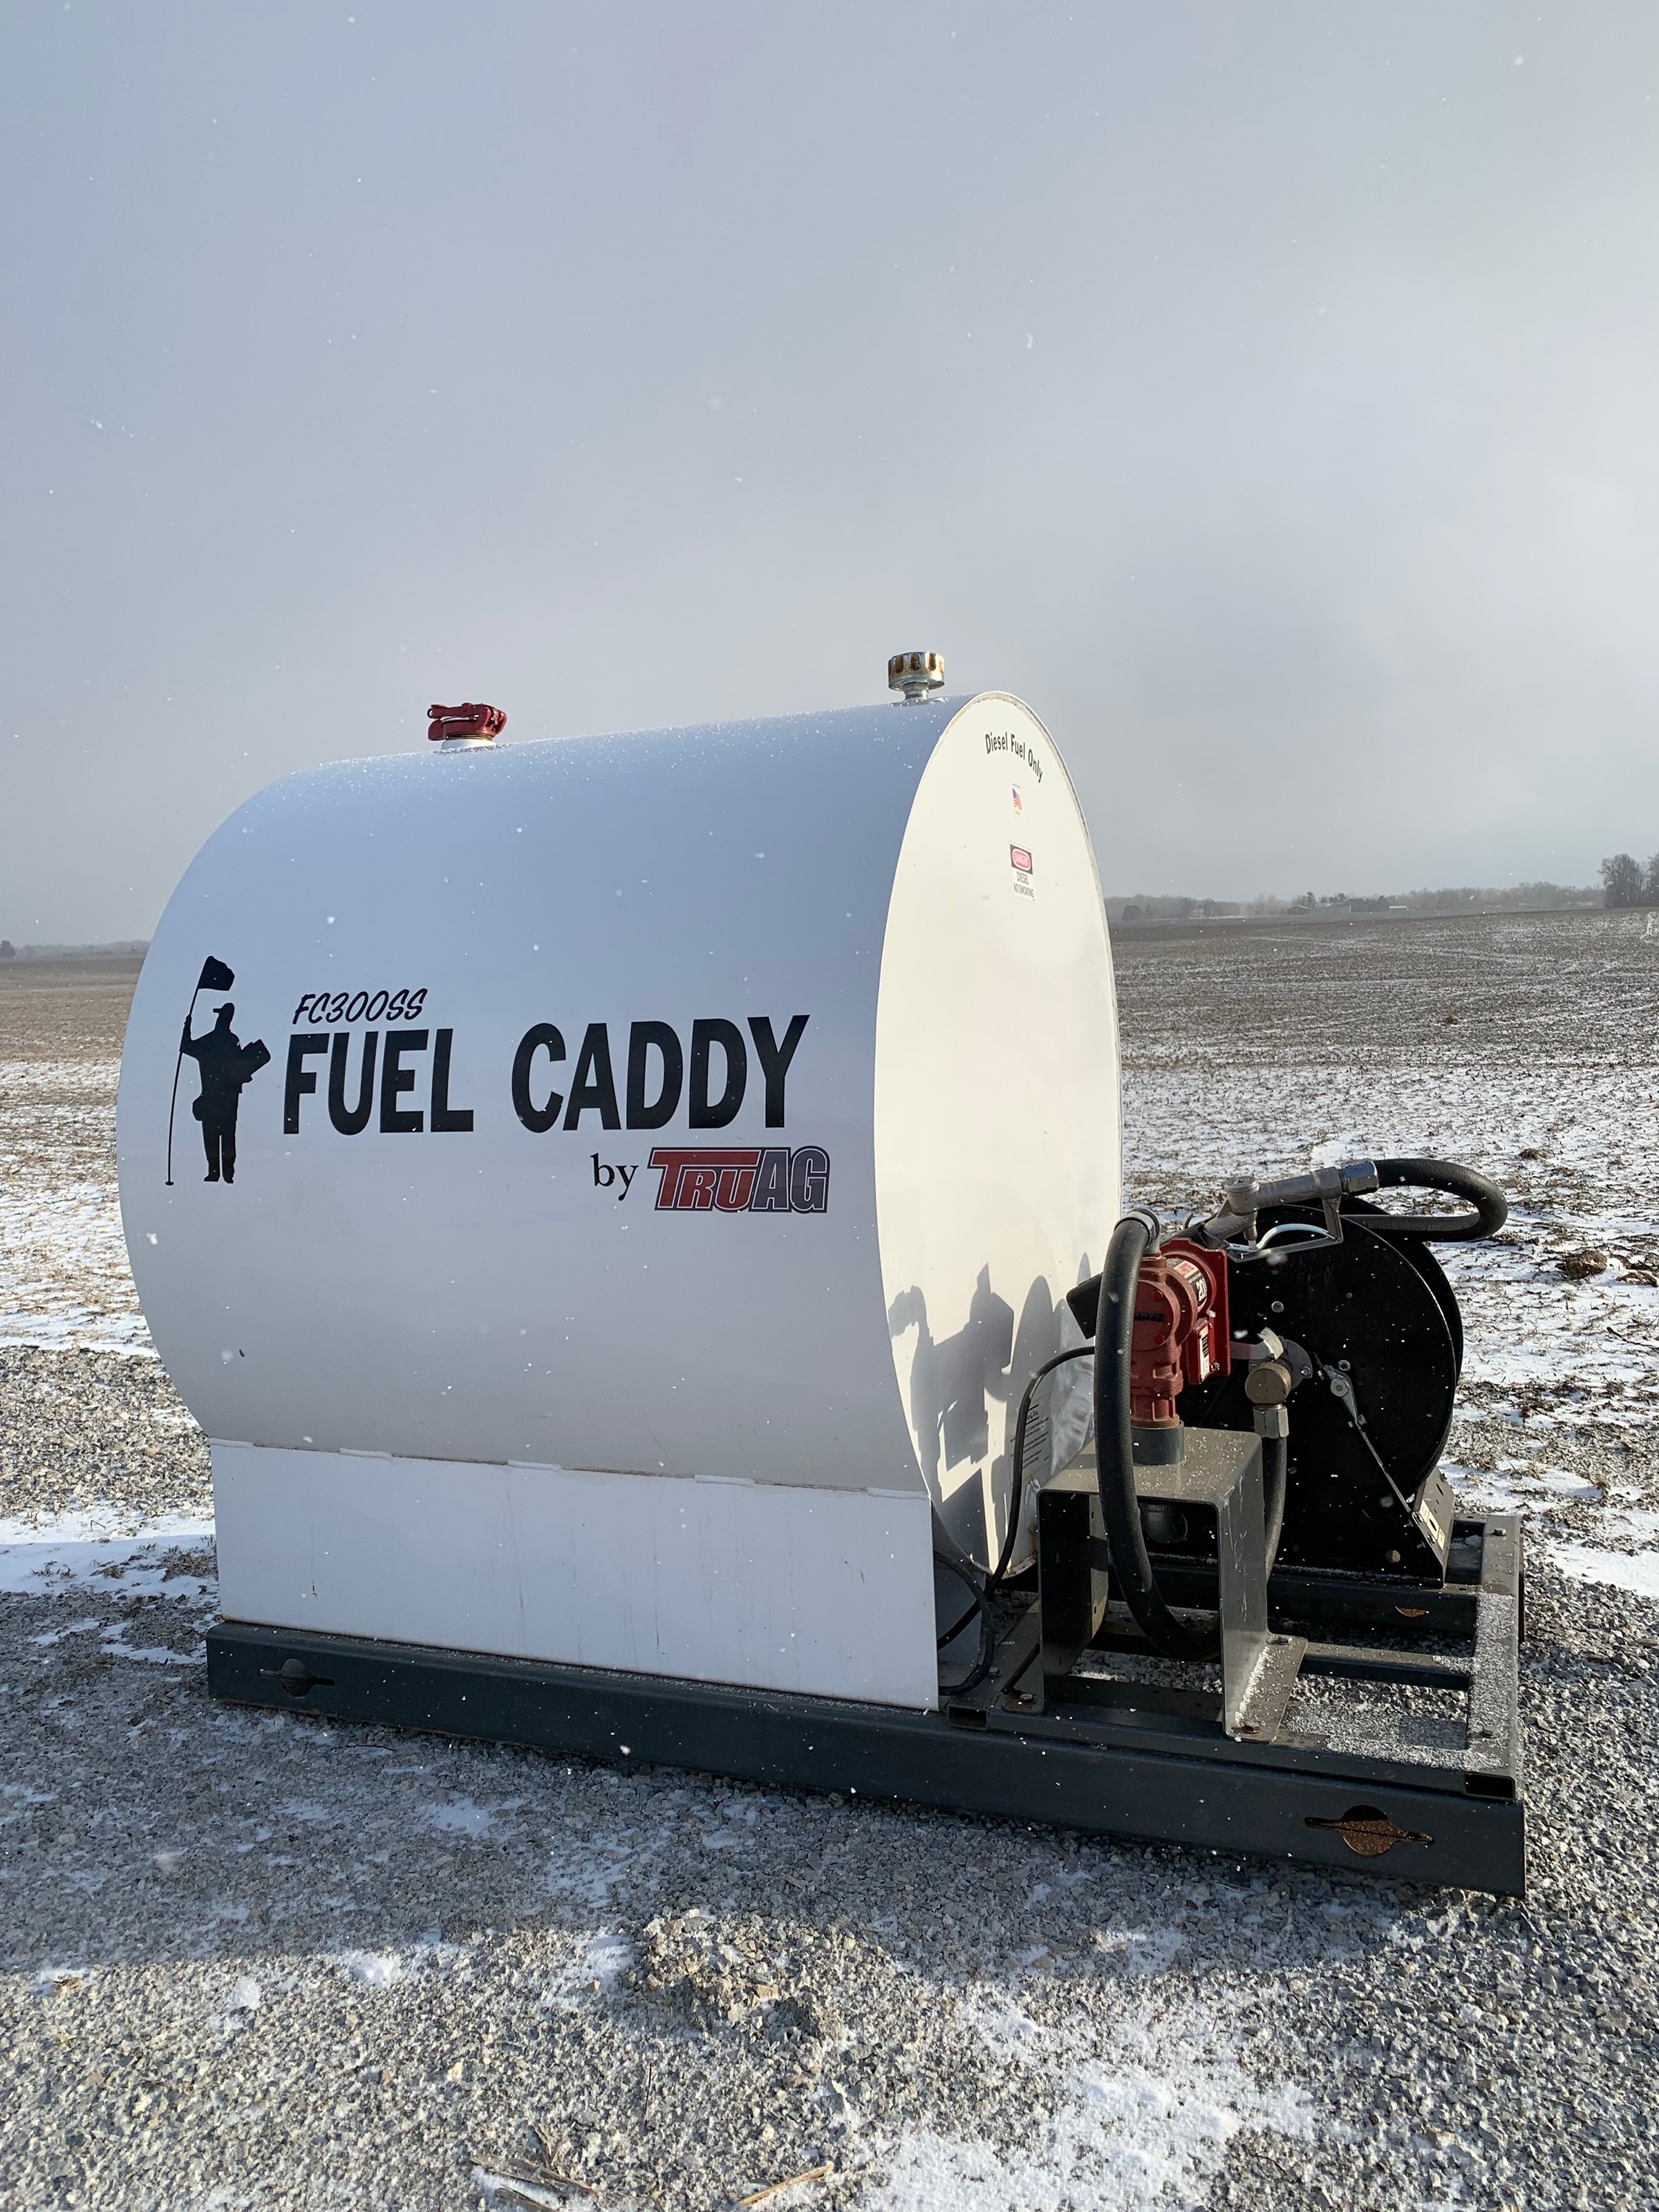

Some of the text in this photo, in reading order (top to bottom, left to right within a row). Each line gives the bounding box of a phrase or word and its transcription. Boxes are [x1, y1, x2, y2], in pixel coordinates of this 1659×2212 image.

[985, 731, 1042, 783] Diesel Fuel Only
[1013, 883, 1034, 898] NO SMOKING
[1017, 871, 1029, 885] DIESEL
[292, 988, 428, 1024] FC300SS
[283, 1014, 810, 1136] FUEL CADDY
[590, 1153, 639, 1201] by
